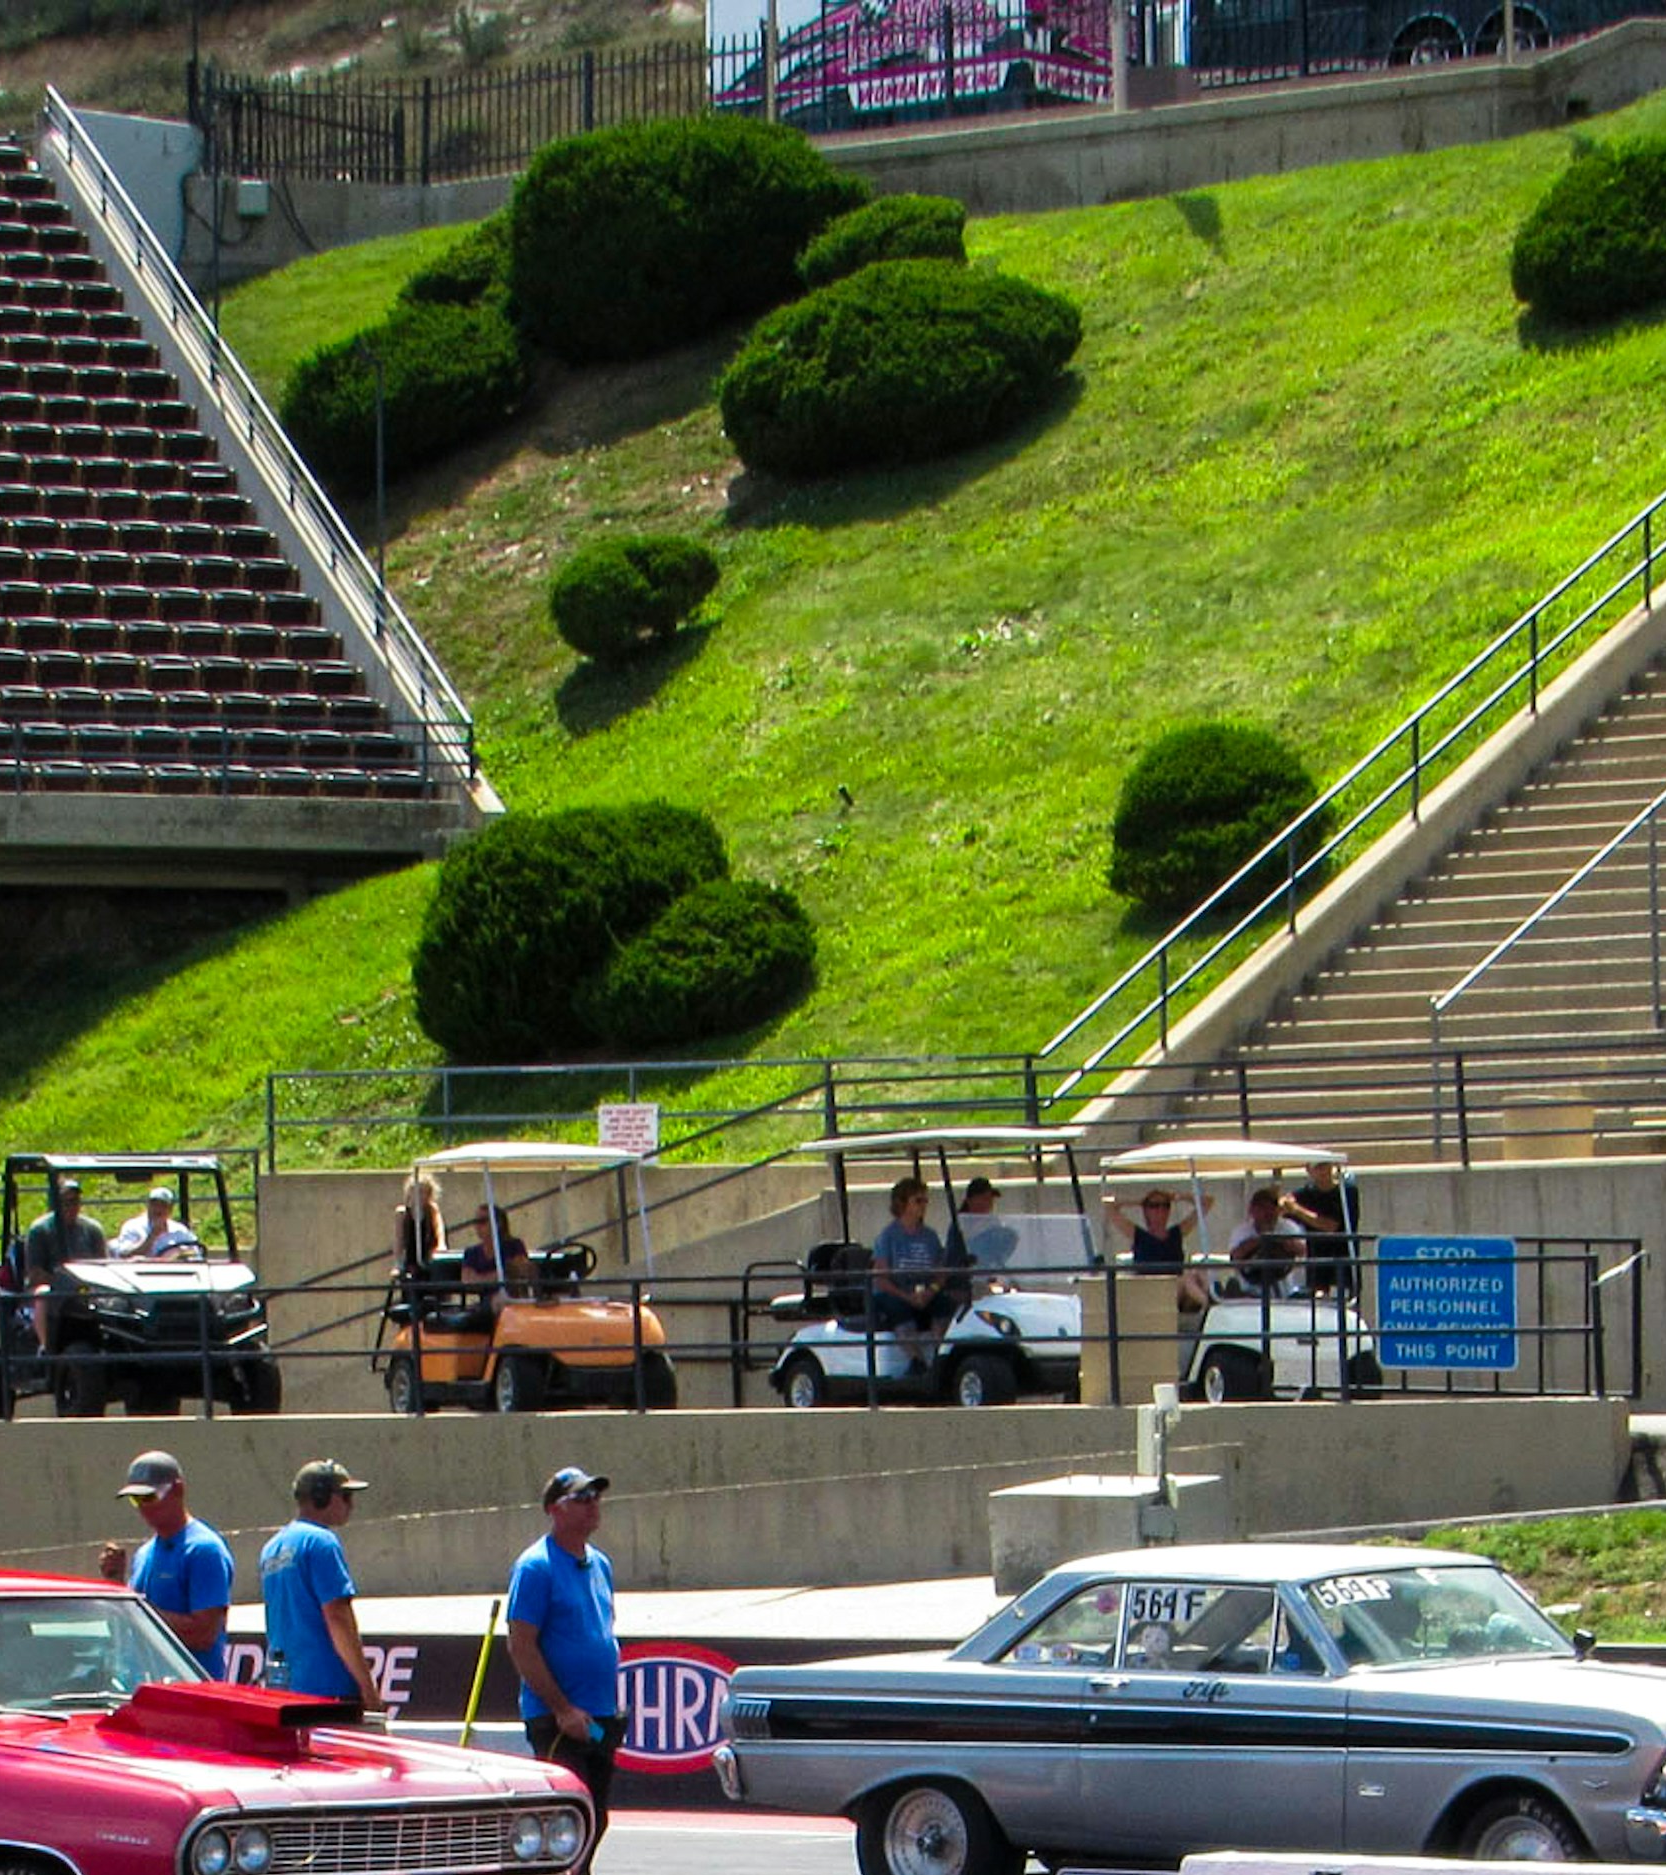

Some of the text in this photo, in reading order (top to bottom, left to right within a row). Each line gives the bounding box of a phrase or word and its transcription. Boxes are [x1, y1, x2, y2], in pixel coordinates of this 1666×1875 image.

[1389, 1277, 1504, 1293] AUTHORIZED
[1390, 1298, 1501, 1316] PERSONNEL
[1395, 1343, 1499, 1361] THIS POINT
